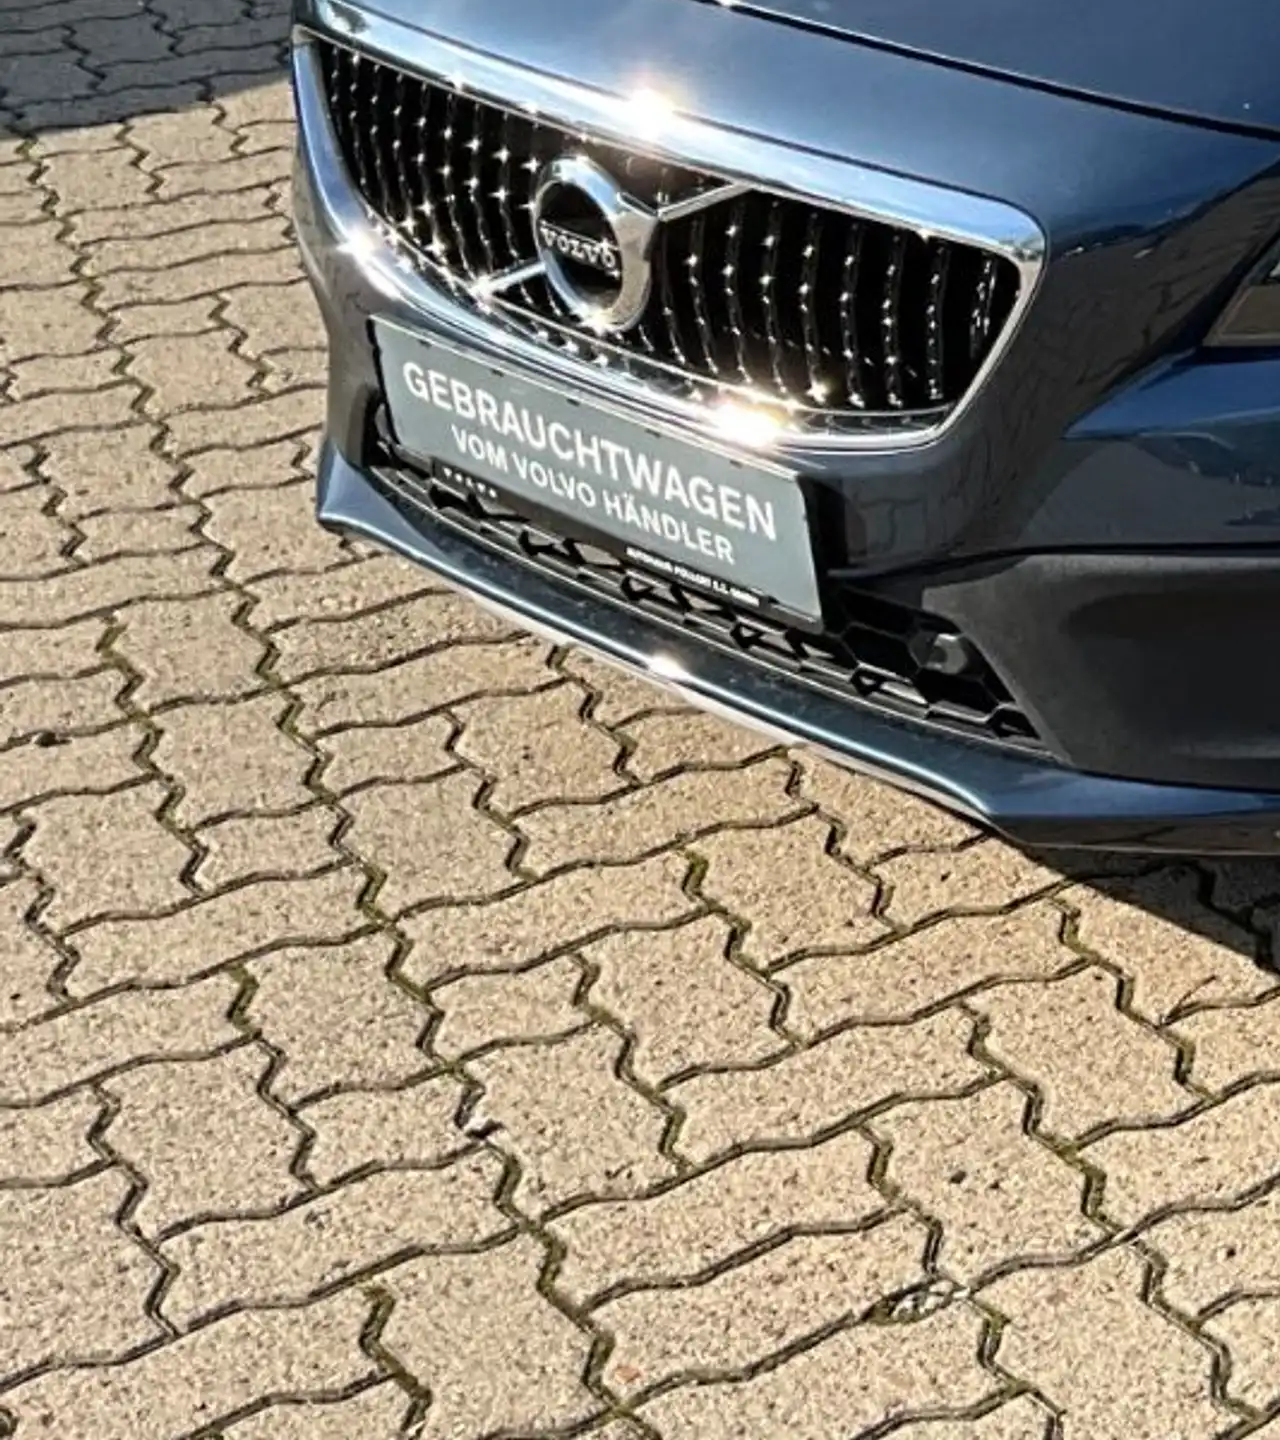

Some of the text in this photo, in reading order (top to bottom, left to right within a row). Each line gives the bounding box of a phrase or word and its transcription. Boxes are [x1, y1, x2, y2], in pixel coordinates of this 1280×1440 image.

[540, 227, 616, 268] VOLVO
[402, 362, 777, 541] GEBRAUCHTWAGEN
[451, 424, 735, 565] VOM VOLVO HÄNDLER
